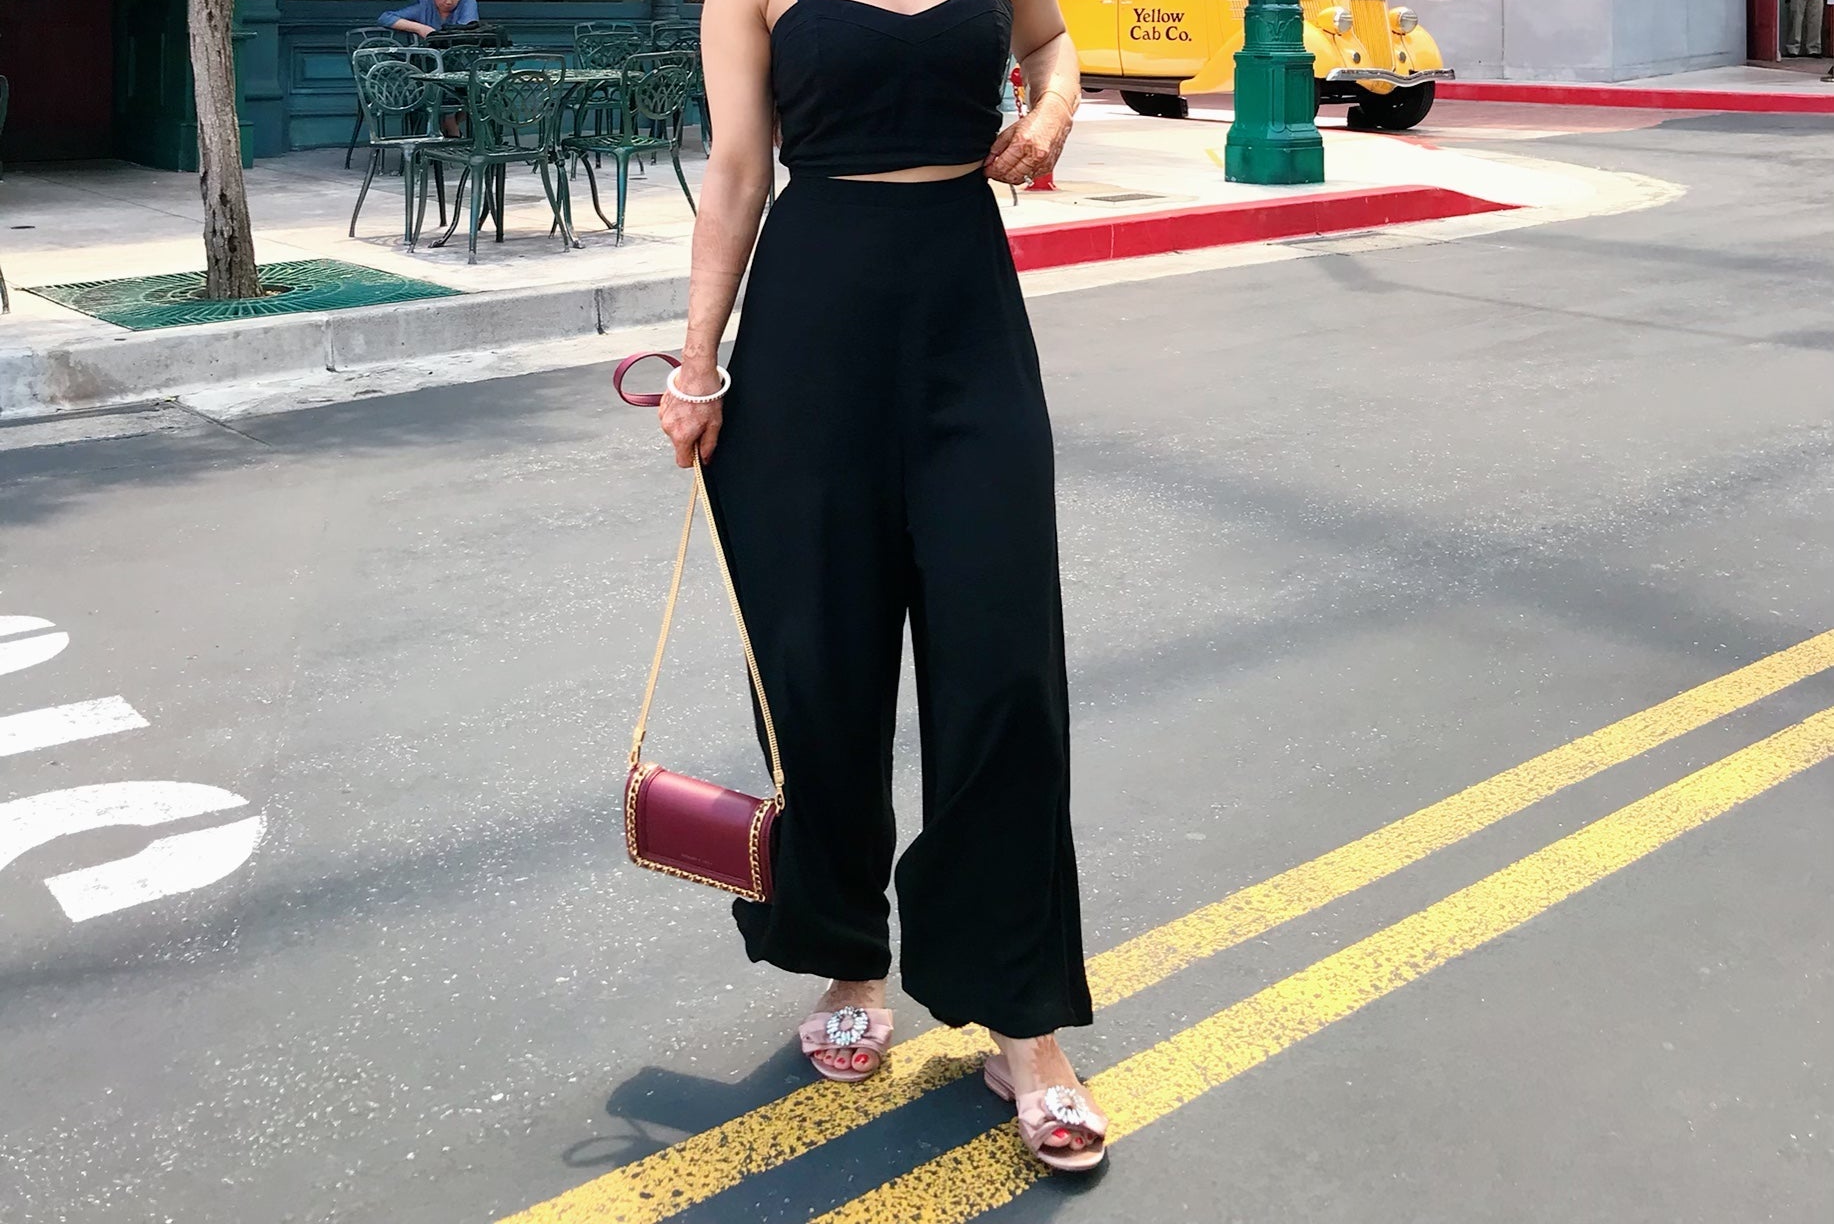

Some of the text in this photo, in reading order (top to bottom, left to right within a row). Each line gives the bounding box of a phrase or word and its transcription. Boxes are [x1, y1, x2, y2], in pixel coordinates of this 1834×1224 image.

[1133, 8, 1185, 23] Yellow
[1129, 25, 1193, 42] Cab Co.
